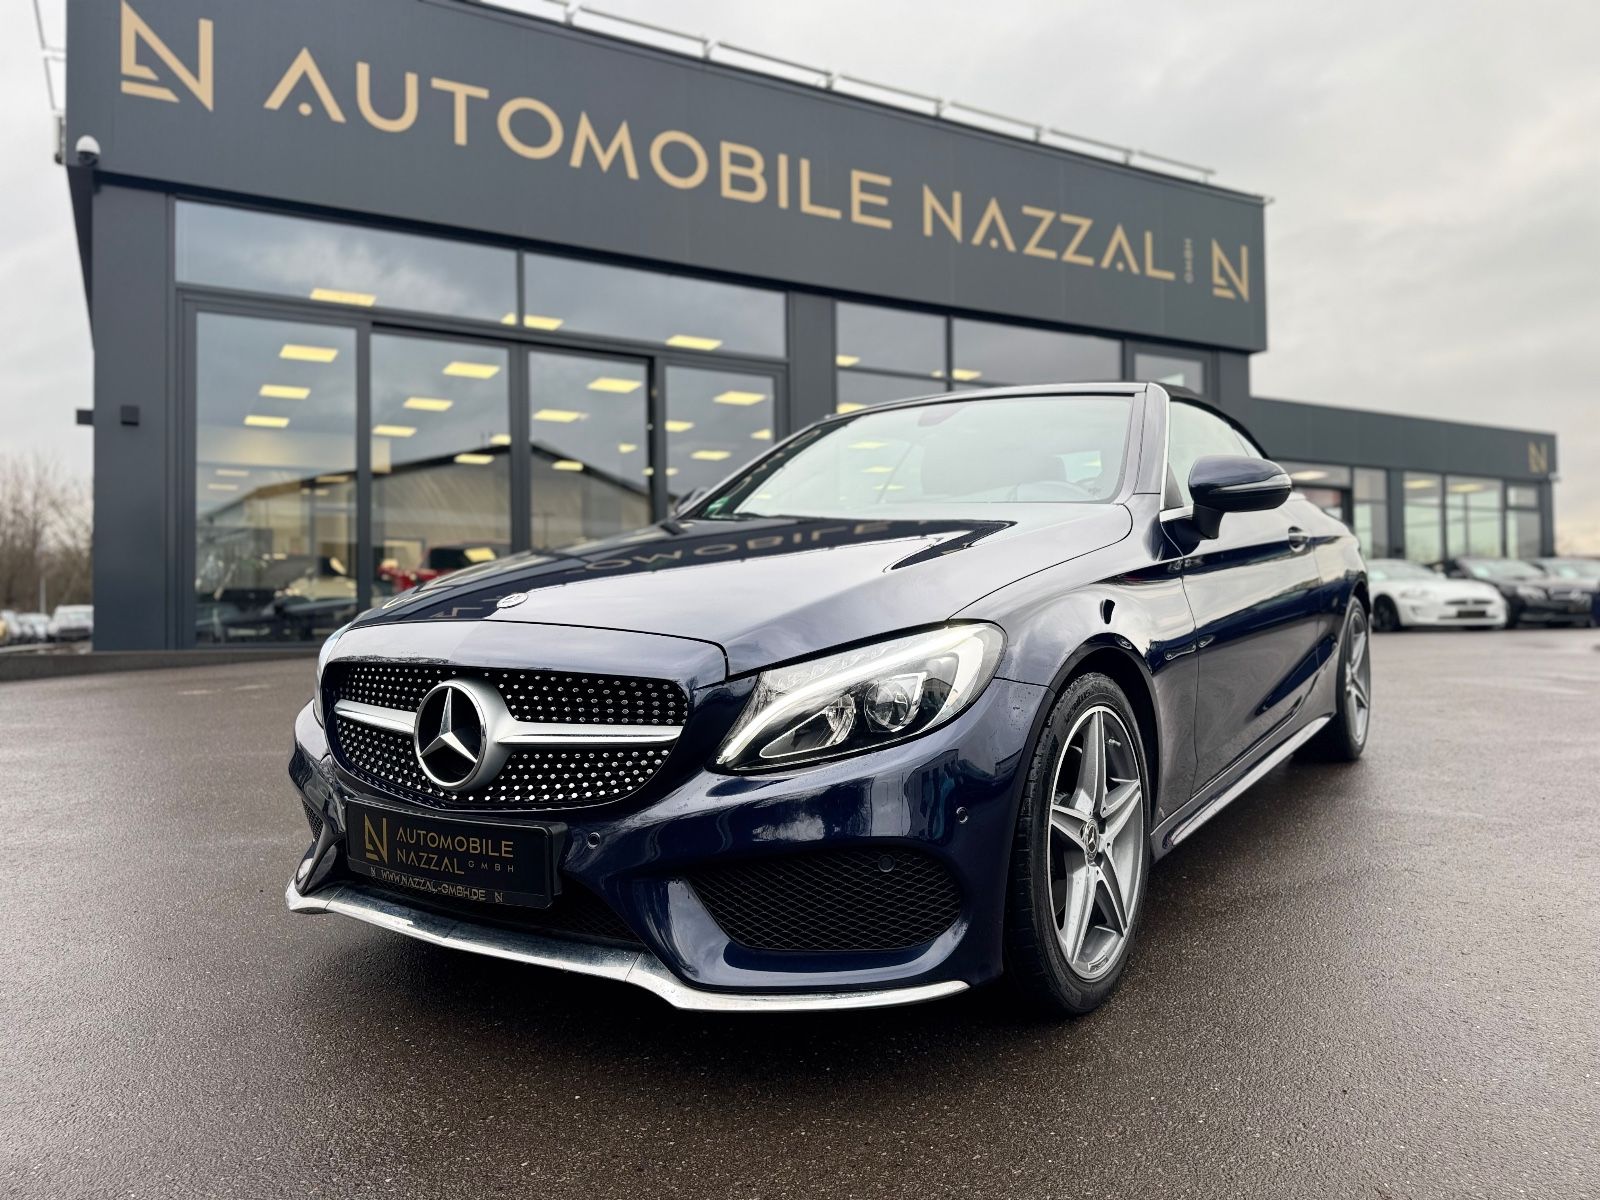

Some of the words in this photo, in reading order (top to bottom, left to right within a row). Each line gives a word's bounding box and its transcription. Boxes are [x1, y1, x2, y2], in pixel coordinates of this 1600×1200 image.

[263, 46, 893, 231] AUTOMOBILE
[922, 184, 1176, 281] NAZZAL
[397, 827, 514, 858] AUTOMOBILE
[397, 849, 465, 875] NAZZAL
[468, 860, 514, 873] GMBH
